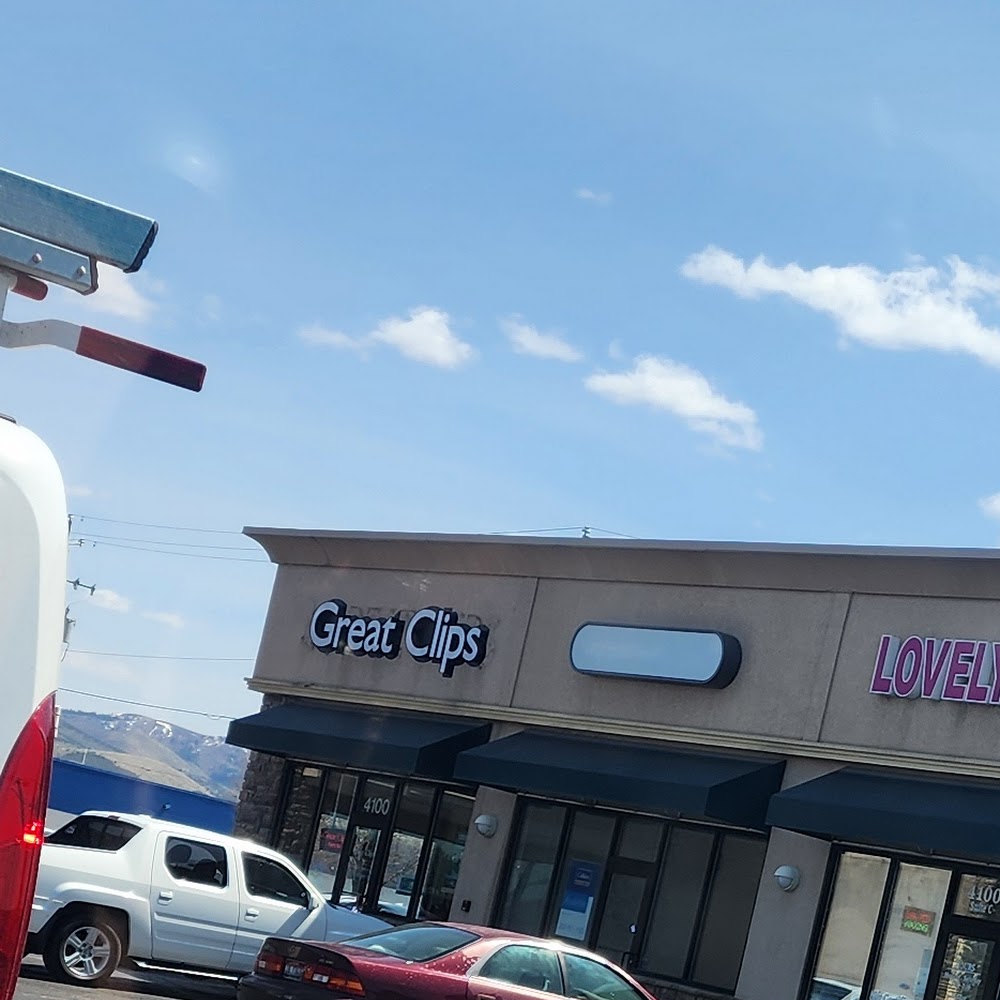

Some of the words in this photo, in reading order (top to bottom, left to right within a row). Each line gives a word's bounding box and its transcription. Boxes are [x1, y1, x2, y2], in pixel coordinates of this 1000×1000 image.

[309, 600, 399, 655] Great
[405, 607, 484, 675] Clips
[363, 797, 391, 816] 4100
